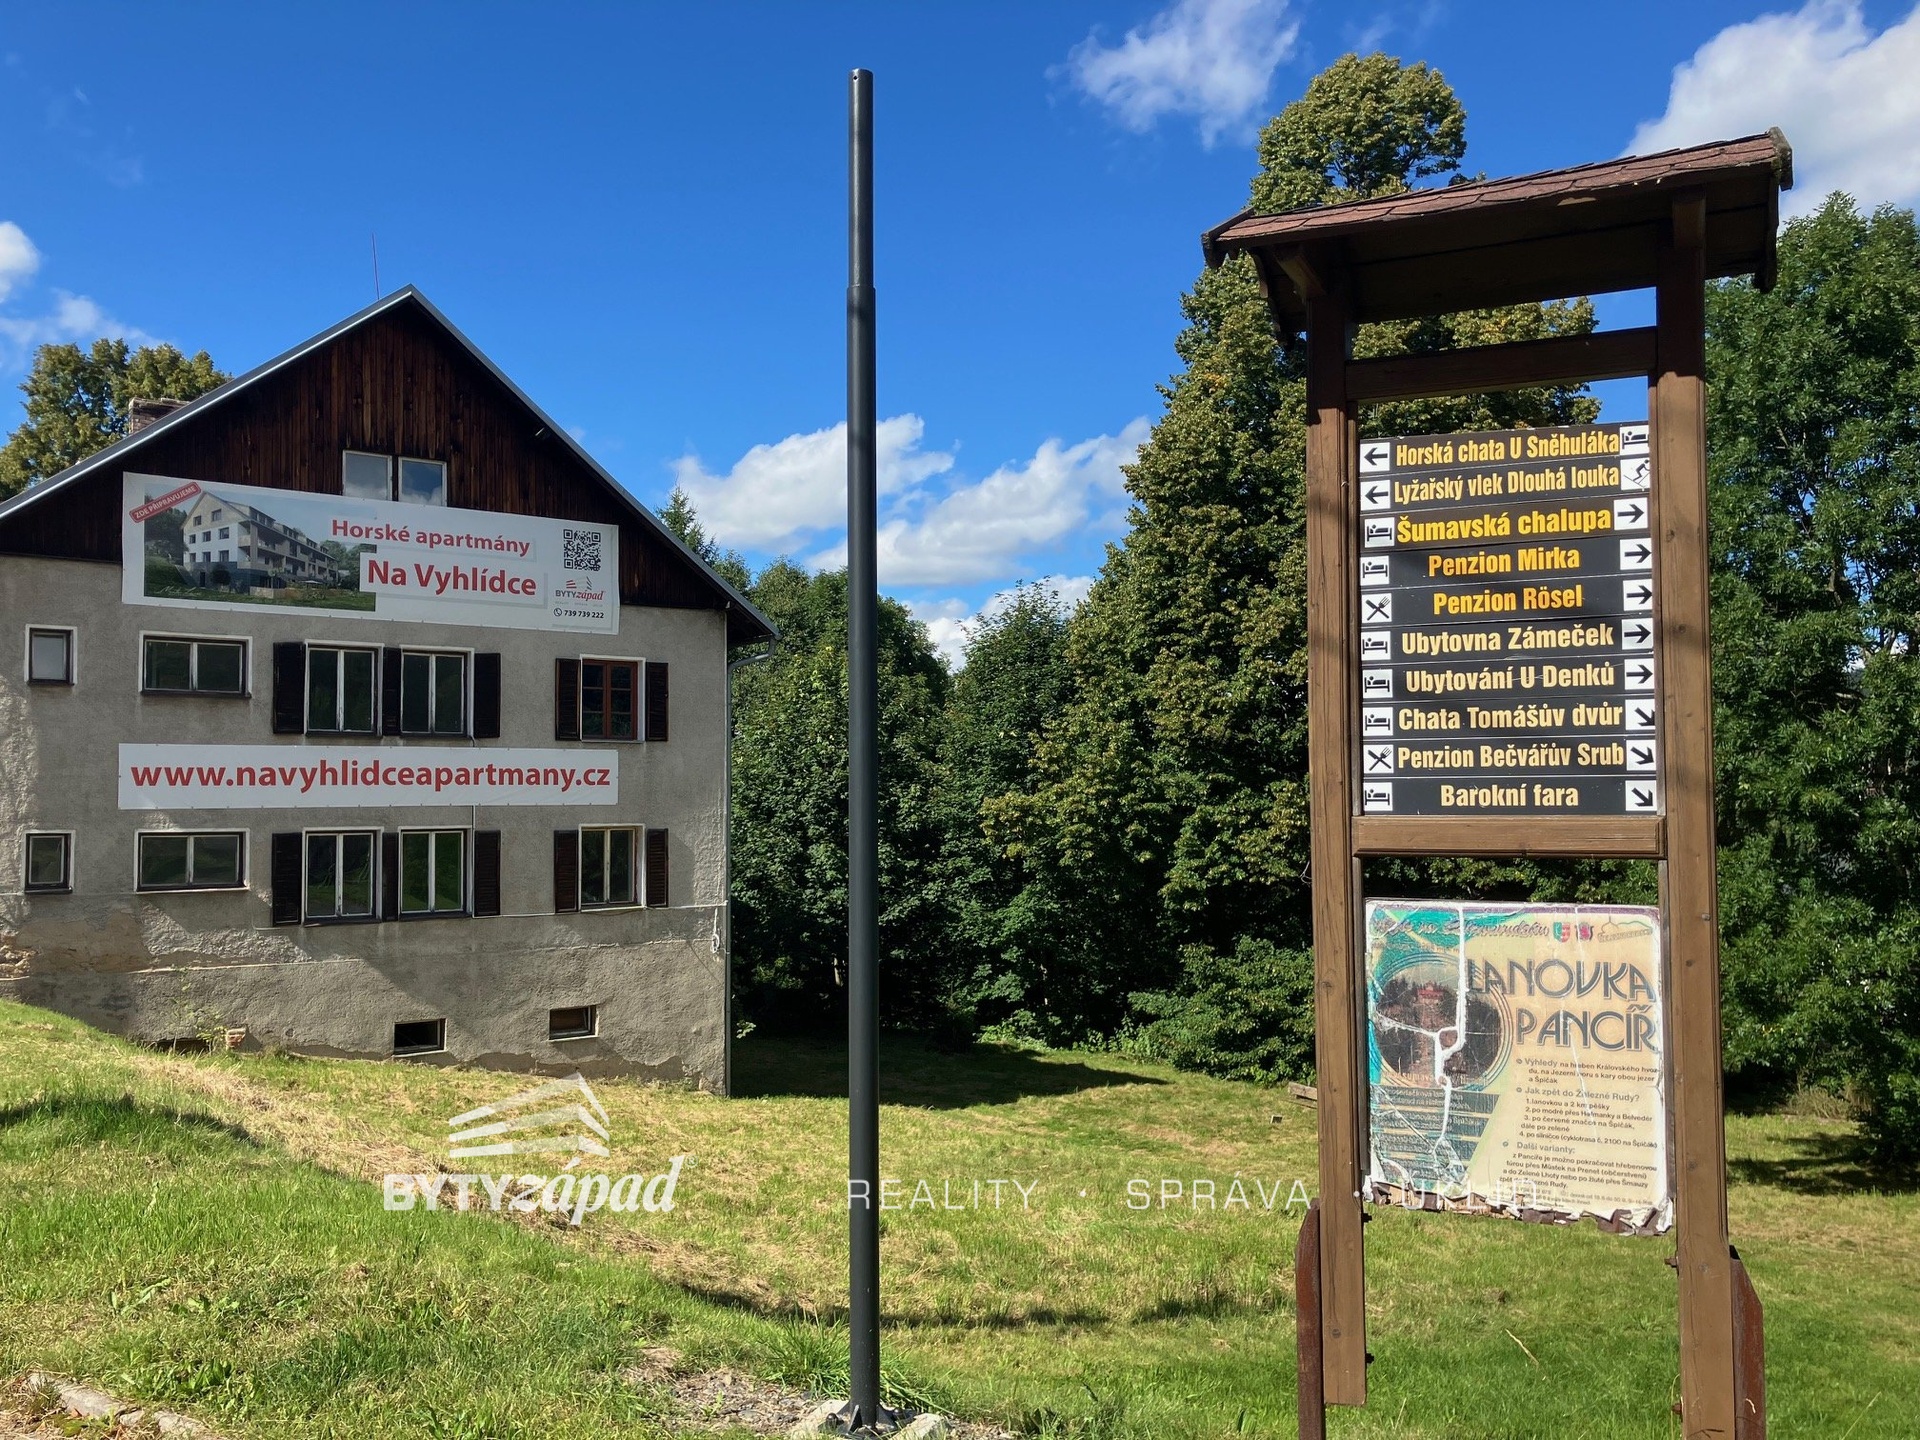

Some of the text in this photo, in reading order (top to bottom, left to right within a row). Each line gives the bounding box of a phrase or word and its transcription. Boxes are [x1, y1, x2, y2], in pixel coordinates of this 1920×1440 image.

[1396, 430, 1619, 467] Horská chata U Sněhuláka
[1394, 464, 1619, 505] Lyžařský vlek Dlouhá louka
[135, 508, 150, 519] ZDE
[1397, 508, 1611, 544] Šumavská chalupa
[332, 519, 530, 557] Horské apartmány
[368, 559, 537, 595] Na Vyhlídce
[1428, 546, 1580, 578] Penzion Mirka
[564, 609, 605, 619] 739 739 222
[1433, 584, 1583, 615] Penzion Rösel
[1401, 623, 1614, 656] Ubytovna Zámeček
[1405, 662, 1615, 693] Ubytování U Denků
[1398, 701, 1623, 731] Chata Tomášův dvůr
[1397, 742, 1625, 769] Penzion Bečvářův Srub
[131, 760, 611, 793] www.navyhlidceapartmany.cz
[1441, 783, 1579, 808] Barokní fara
[1467, 958, 1657, 1002] LANOVKA
[1516, 1003, 1661, 1054] PANCÍŘ
